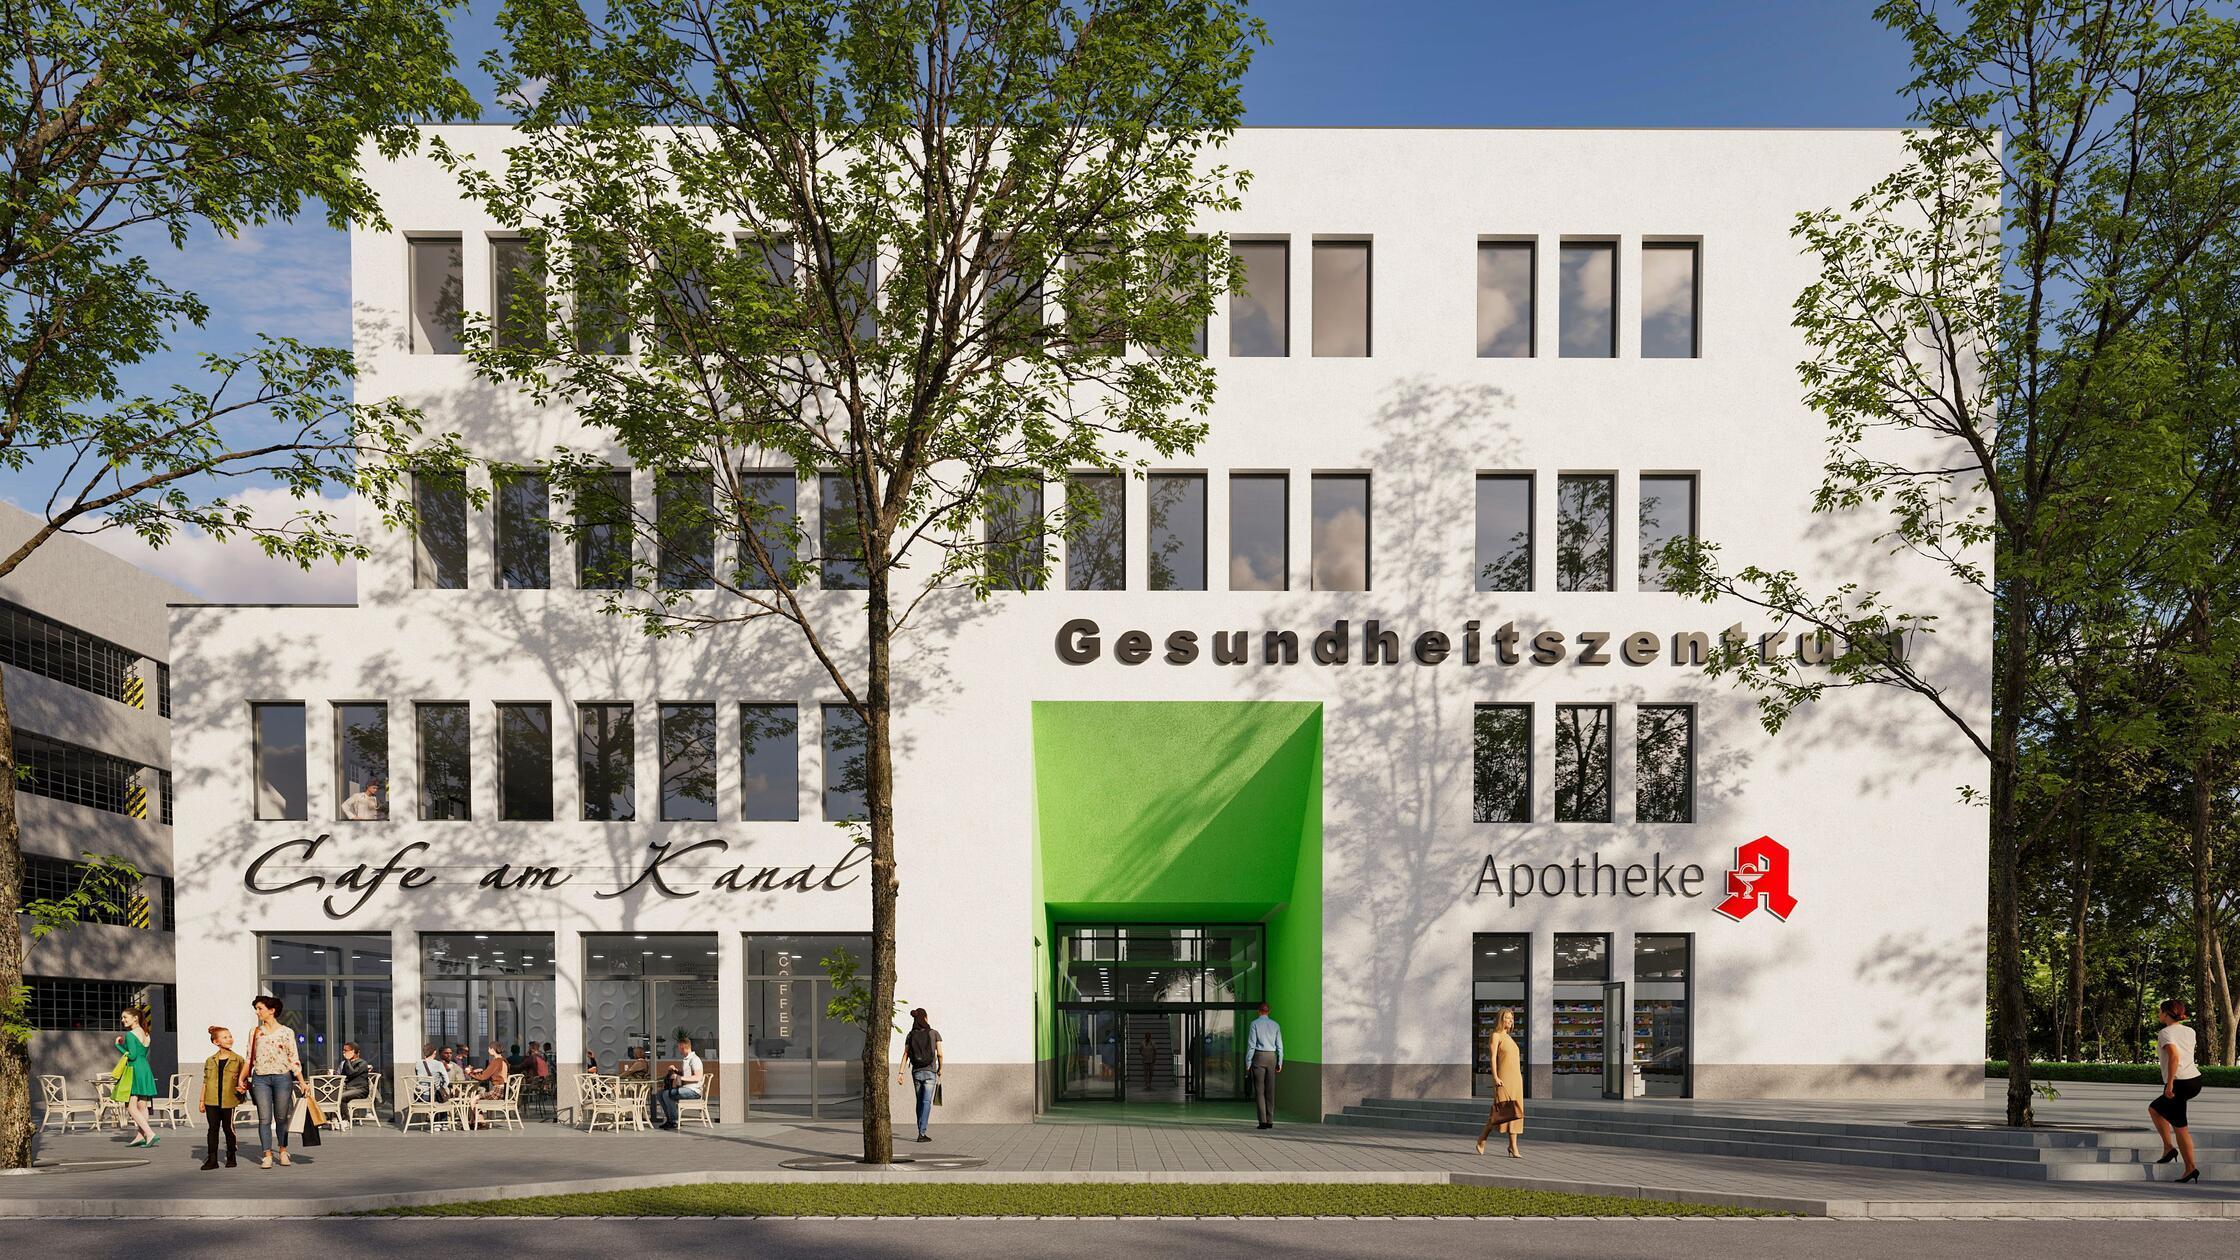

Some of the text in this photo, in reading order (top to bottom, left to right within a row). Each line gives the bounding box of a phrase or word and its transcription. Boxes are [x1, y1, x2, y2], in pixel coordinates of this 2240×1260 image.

[244, 834, 873, 919] Cafe am Kanal
[1473, 852, 1705, 908] Apotheke
